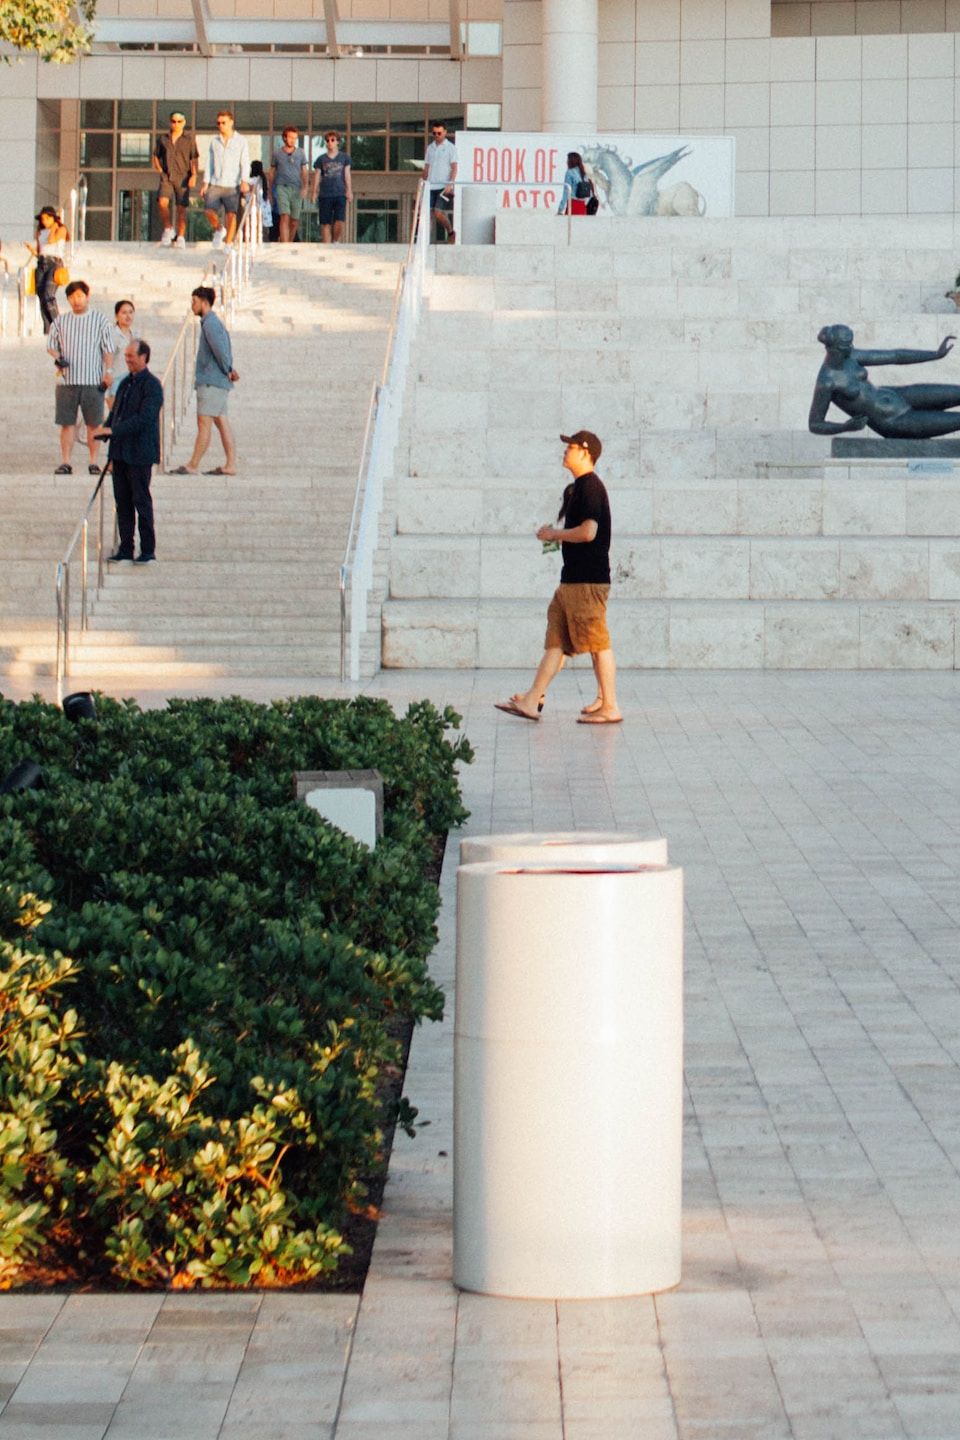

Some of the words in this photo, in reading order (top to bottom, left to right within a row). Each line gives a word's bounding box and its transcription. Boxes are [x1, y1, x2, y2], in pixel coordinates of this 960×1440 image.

[473, 147, 526, 183] BOOK
[534, 148, 558, 183] OF
[495, 189, 556, 209] ASTS
